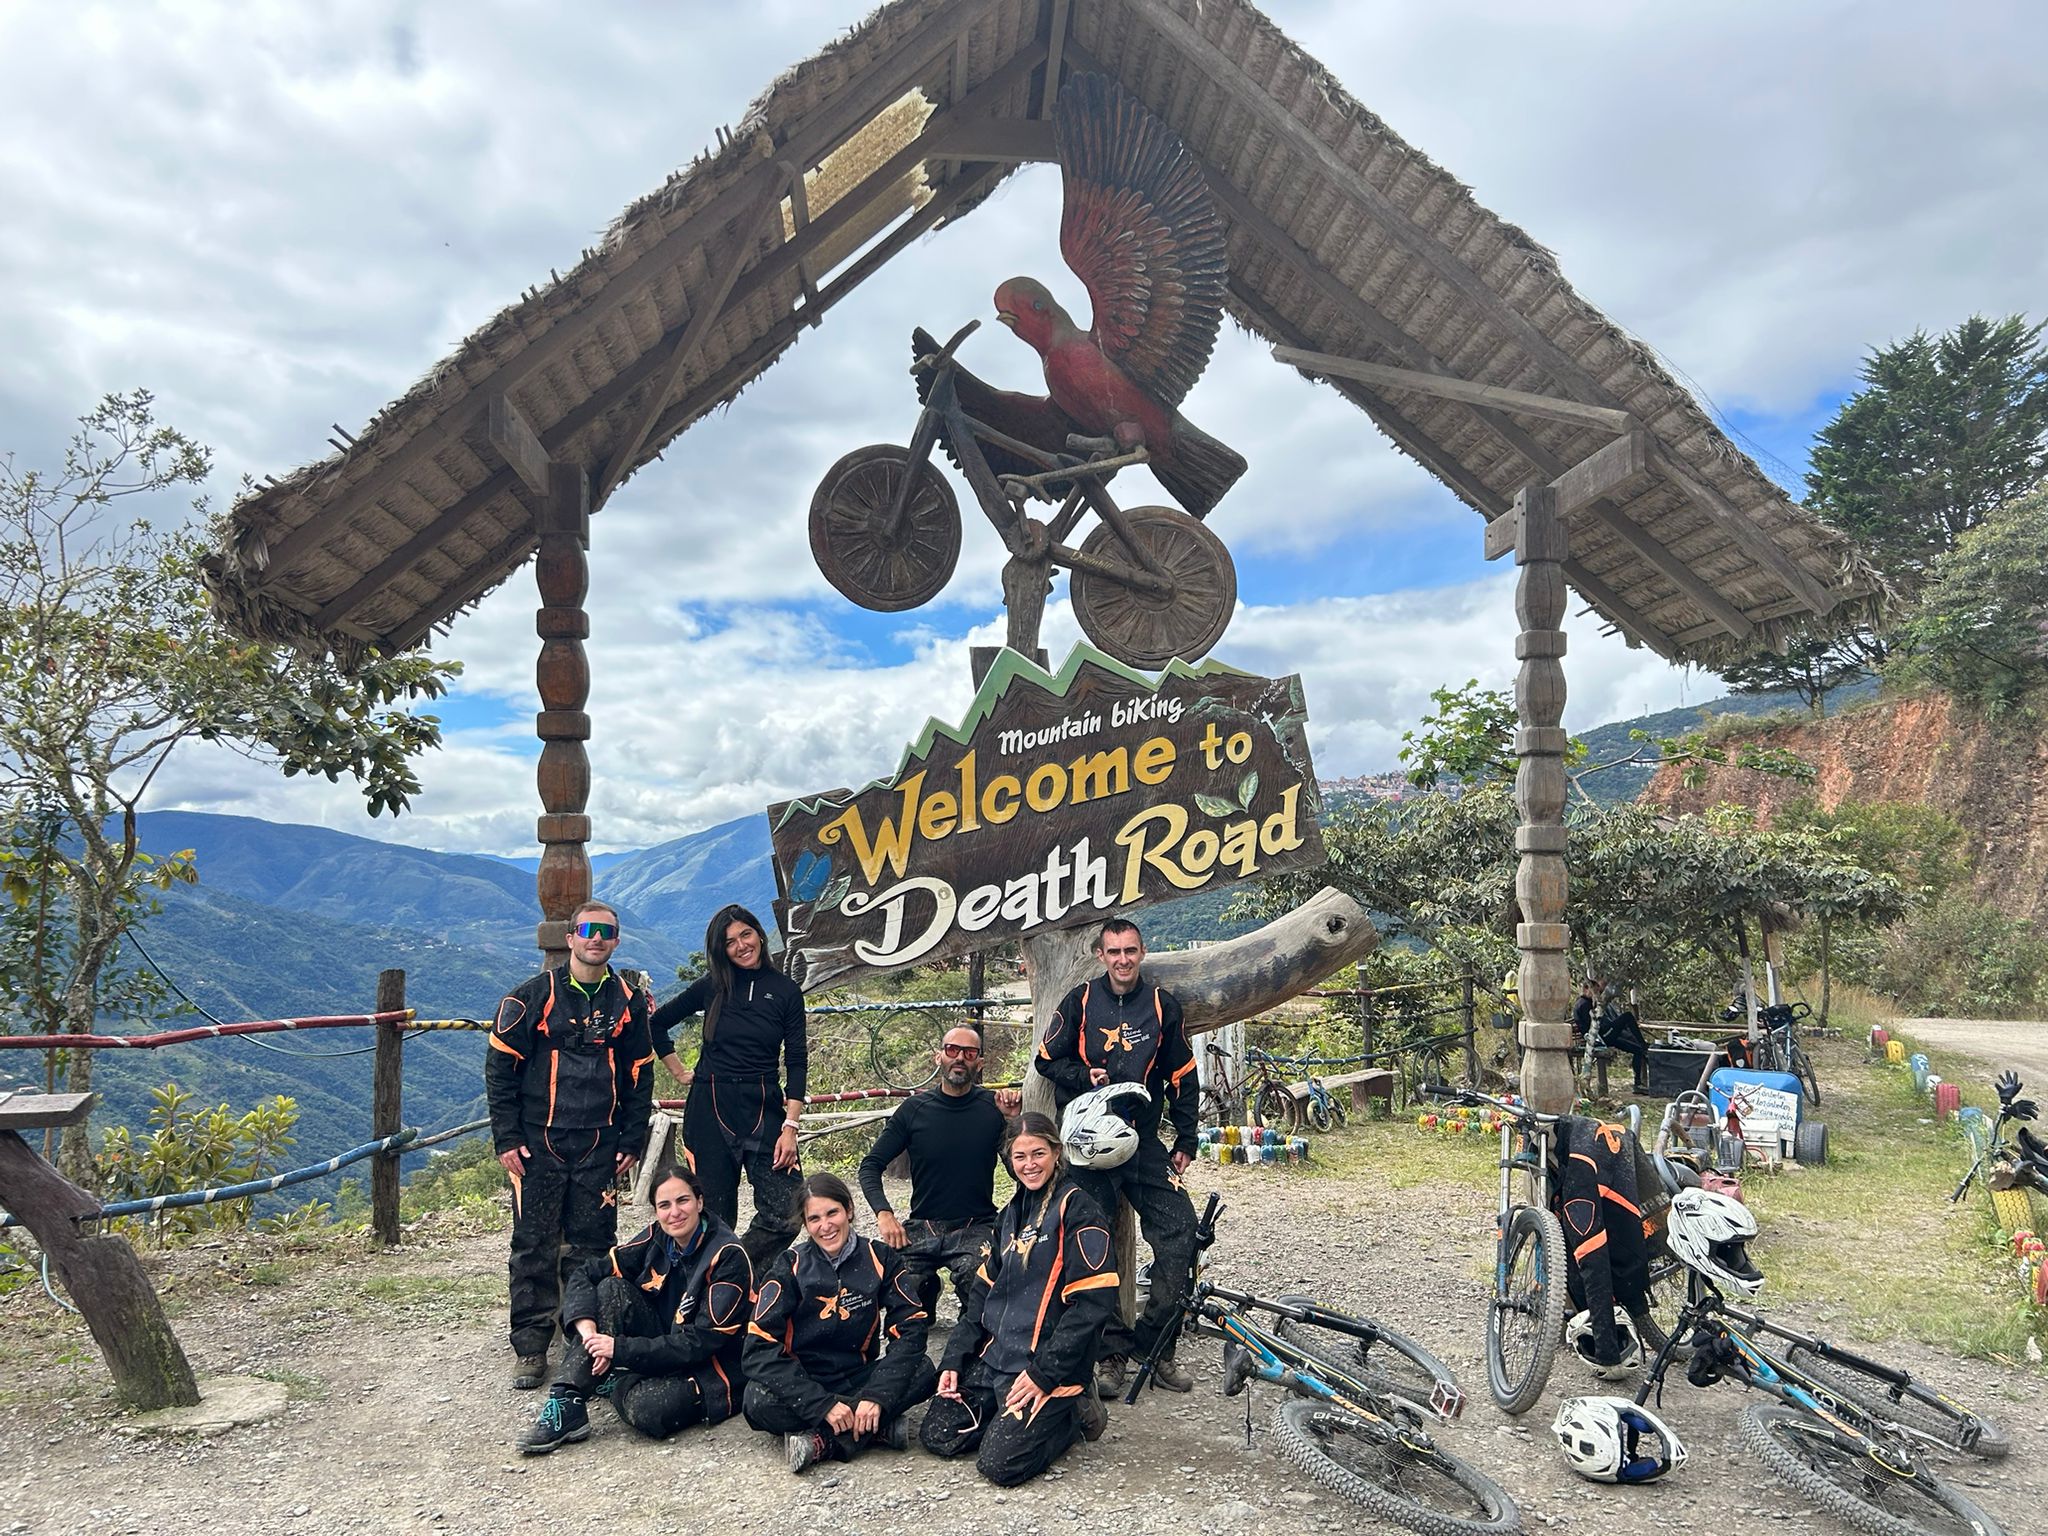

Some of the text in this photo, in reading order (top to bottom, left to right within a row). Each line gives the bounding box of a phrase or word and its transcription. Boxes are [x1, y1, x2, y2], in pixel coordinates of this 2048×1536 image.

[818, 722, 1254, 887] Welcome to
[840, 782, 1306, 968] Death Road
